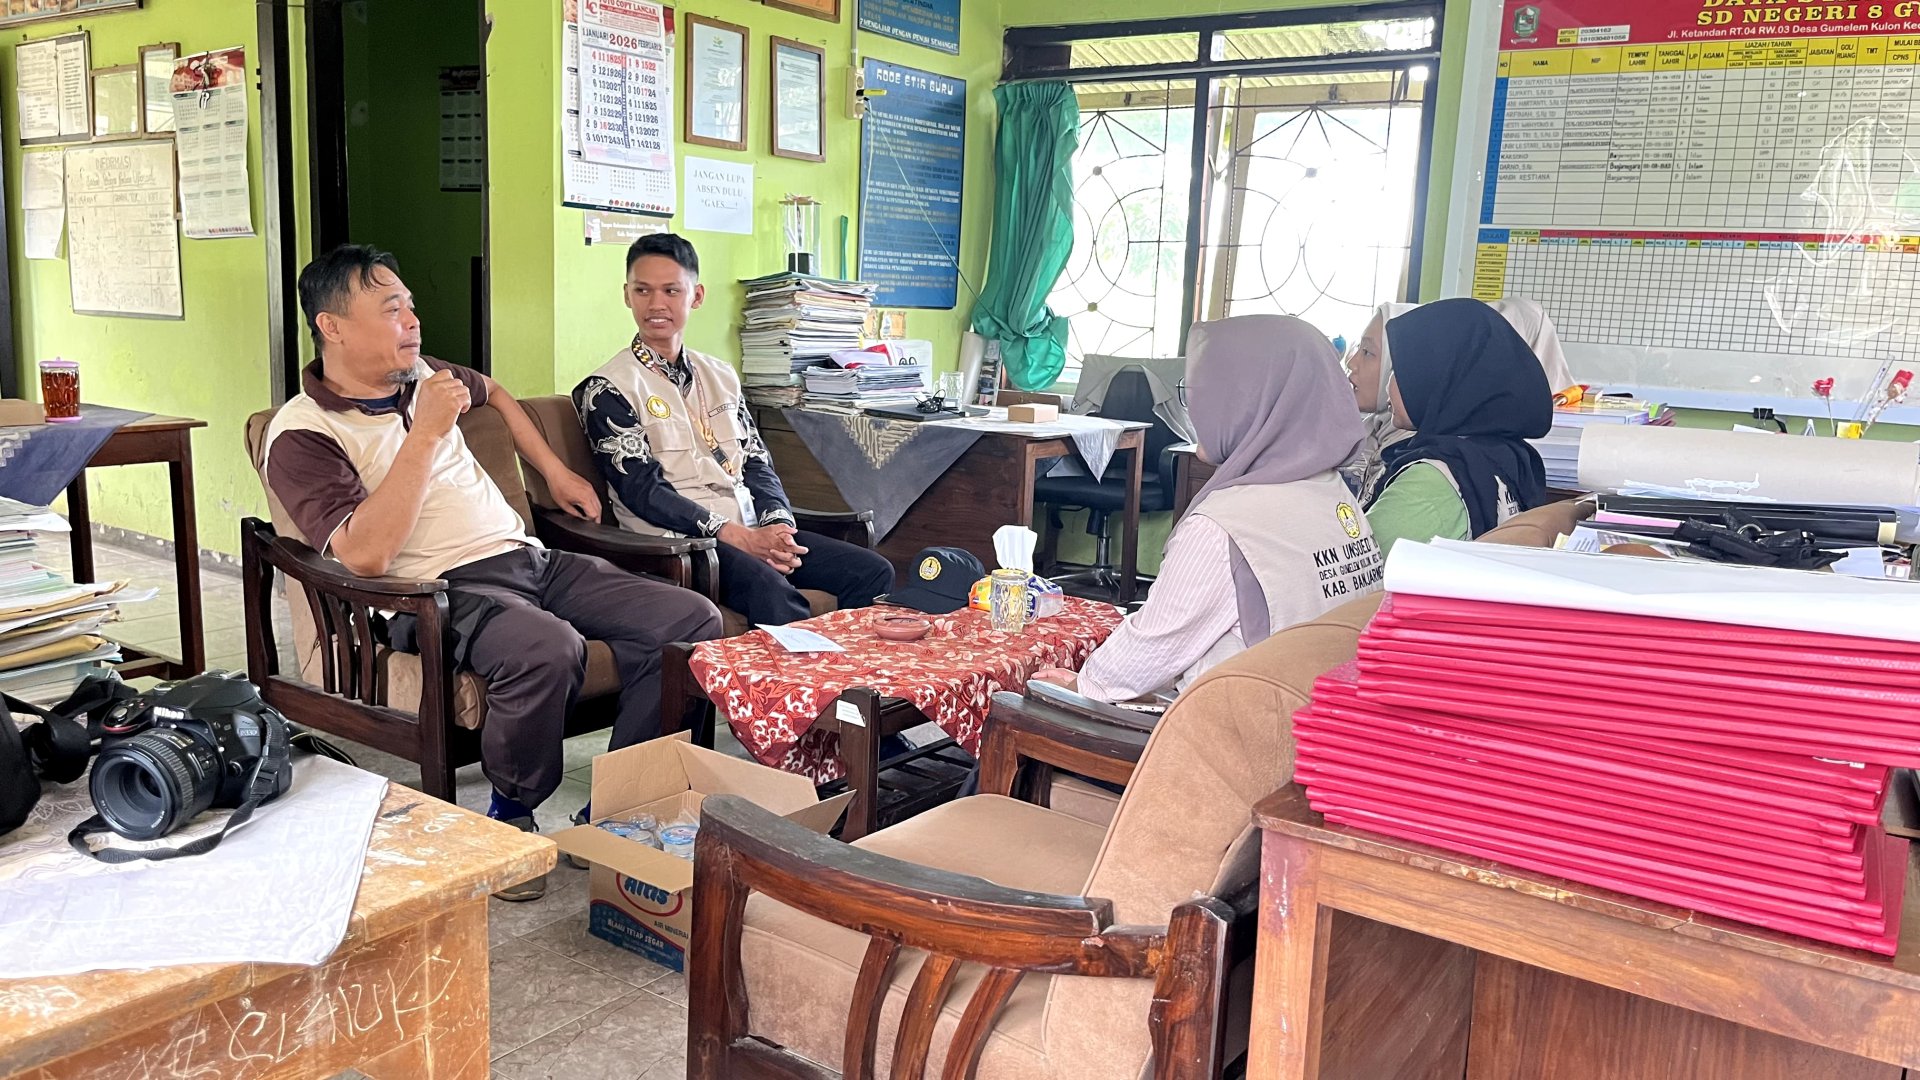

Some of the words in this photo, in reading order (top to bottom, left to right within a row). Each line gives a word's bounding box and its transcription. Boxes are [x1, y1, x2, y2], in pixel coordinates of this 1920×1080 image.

[634, 4, 656, 15] LANCAR
[1697, 10, 1733, 25] SD
[1742, 5, 1858, 23] NEGERI
[1868, 5, 1883, 19] 8
[586, 28, 608, 41] JANUARI
[1681, 28, 1727, 38] Ketandan
[1730, 26, 1756, 35] RT.04
[1758, 25, 1790, 35] RW.03
[1792, 24, 1817, 33] Desa
[1820, 23, 1868, 33] Gumelem
[1871, 21, 1901, 31] Kulon
[609, 33, 638, 49] 2026
[892, 27, 912, 39] DENGAN
[931, 38, 958, 50] SEMANGAT
[1658, 49, 1685, 57] TANGGAL
[1703, 51, 1725, 59] AGAMA
[1629, 59, 1646, 67] LAHIR
[930, 81, 953, 95] GURU
[694, 170, 725, 181] JANGAN
[726, 174, 746, 184] LUPA
[696, 185, 721, 194] ABSEN
[1313, 548, 1339, 568] KKN
[1343, 538, 1371, 560] UNSOED
[1319, 568, 1338, 581] DESA
[1322, 581, 1350, 599] KAB.
[154, 706, 184, 719] Nikon
